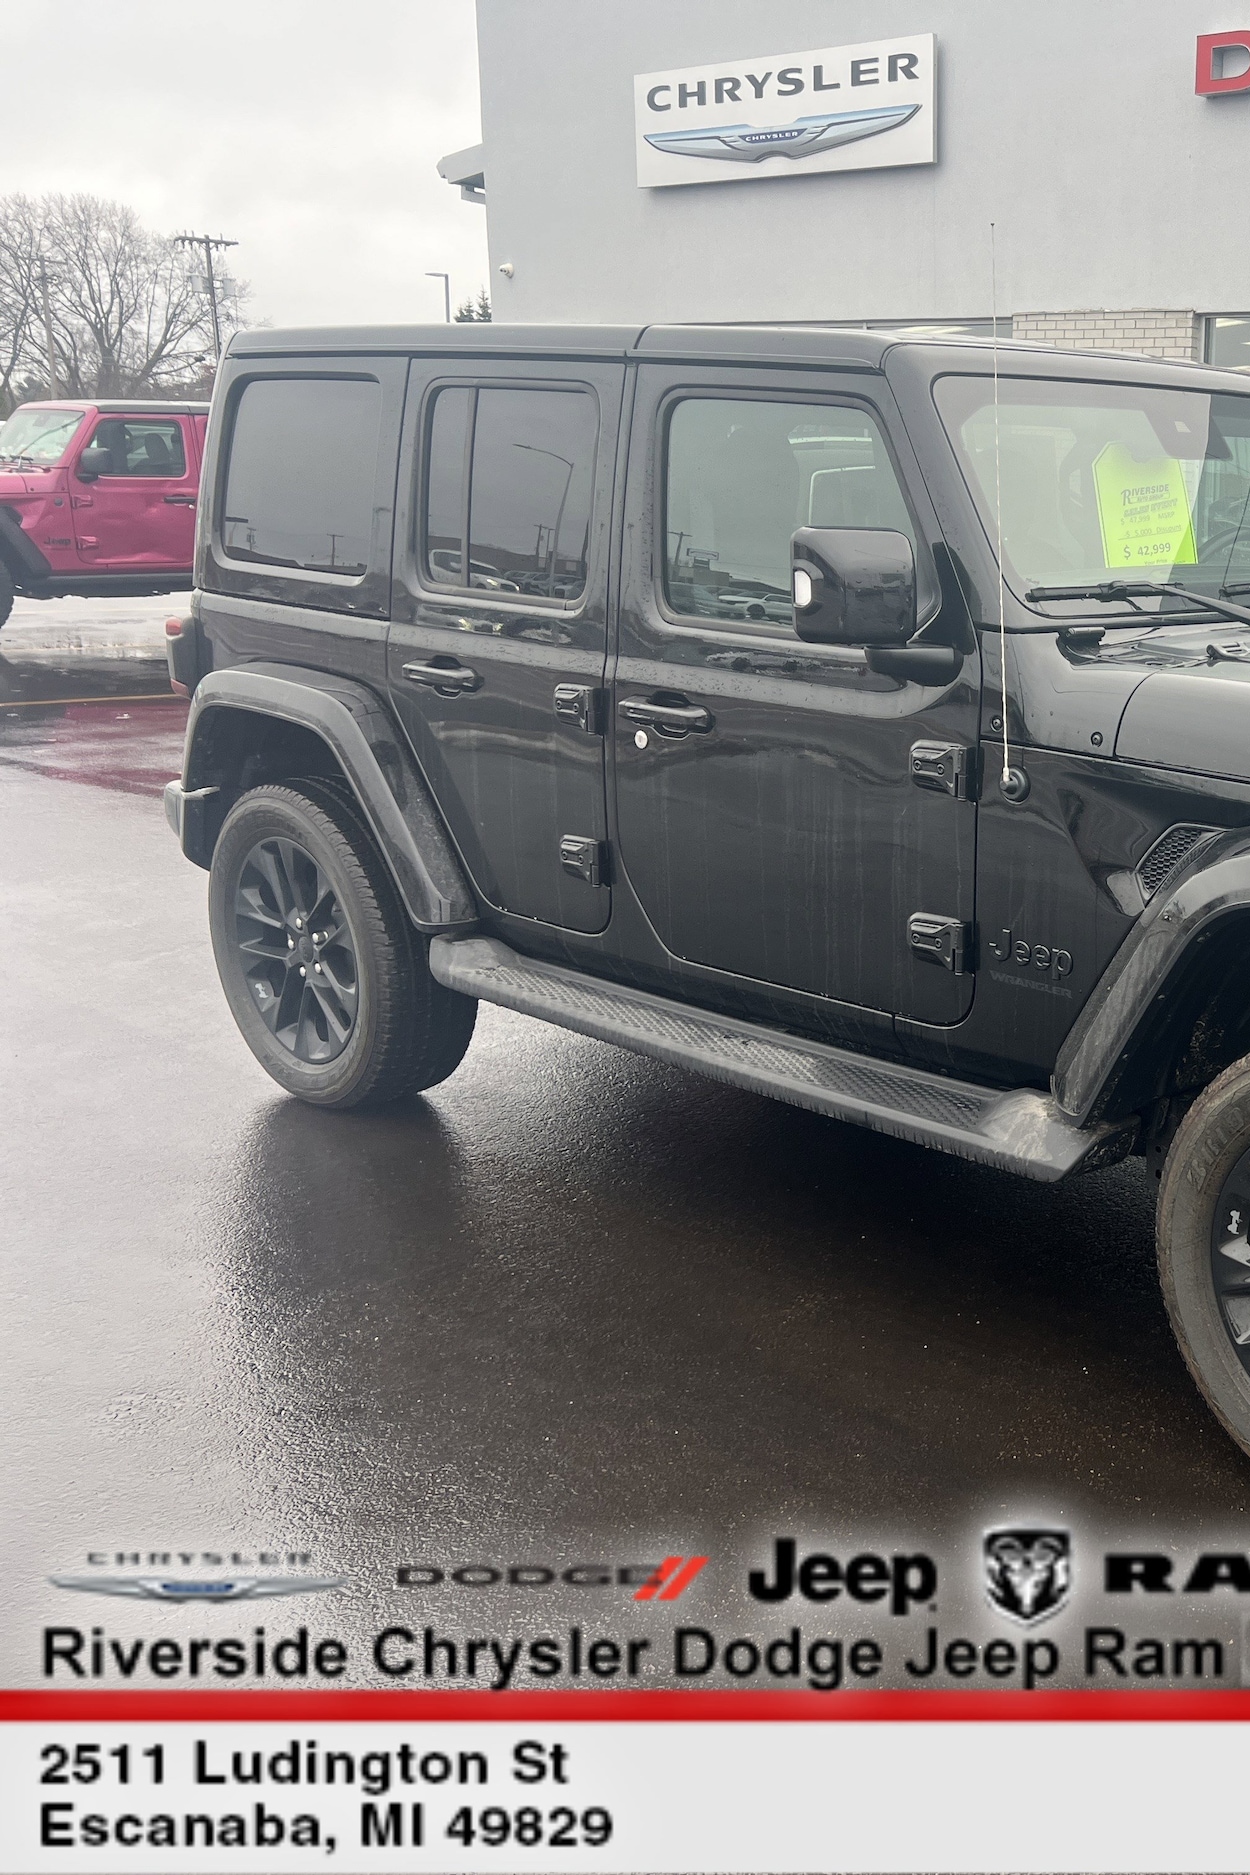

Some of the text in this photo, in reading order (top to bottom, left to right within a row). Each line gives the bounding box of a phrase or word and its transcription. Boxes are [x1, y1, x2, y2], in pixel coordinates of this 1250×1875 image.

[646, 52, 920, 112] CHRYSLER
[745, 131, 798, 142] CHRYSLER
[1120, 484, 1169, 506] RIVERSIDE
[1123, 542, 1171, 560] $ 42,999
[988, 928, 1074, 980] Jeep
[989, 969, 1073, 1000] WRANGLER
